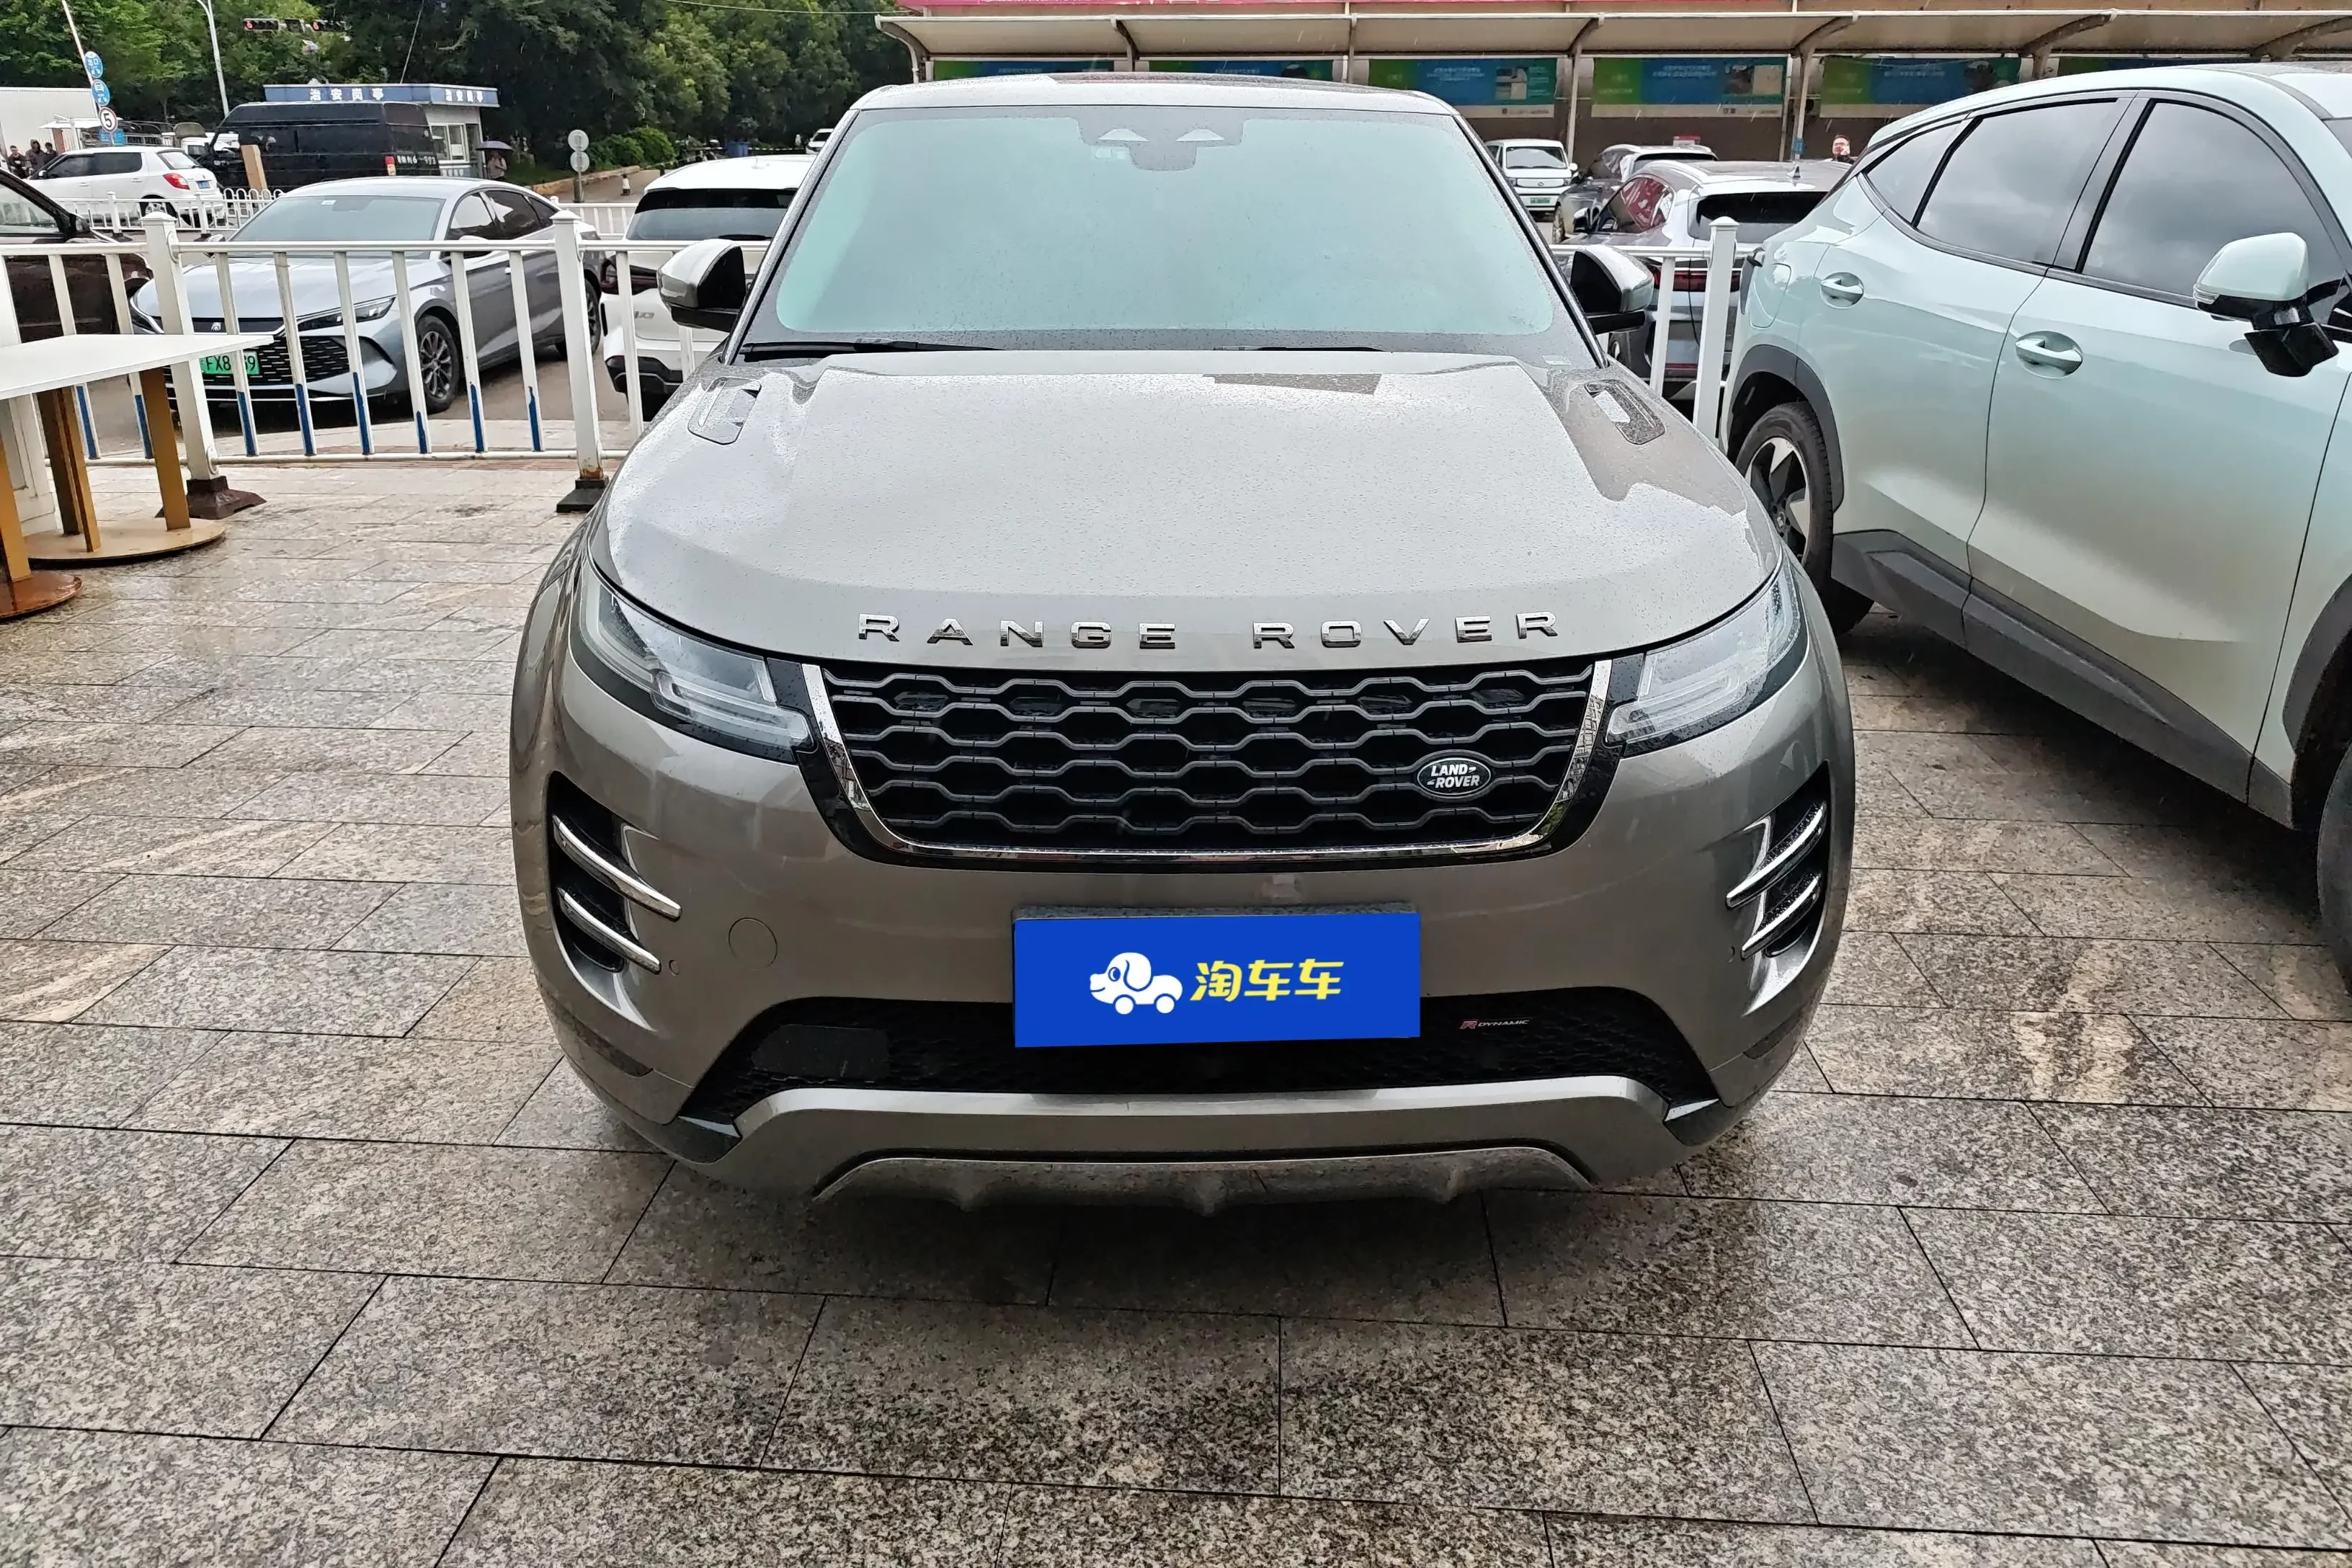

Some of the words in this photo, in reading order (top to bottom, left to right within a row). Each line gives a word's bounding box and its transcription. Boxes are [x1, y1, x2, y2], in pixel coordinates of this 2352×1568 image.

[103, 113, 112, 128] 5
[858, 613, 1176, 649] RANGE
[1252, 610, 1559, 649] ROVER
[1431, 764, 1468, 777] LAND
[1435, 775, 1480, 789] ROVER
